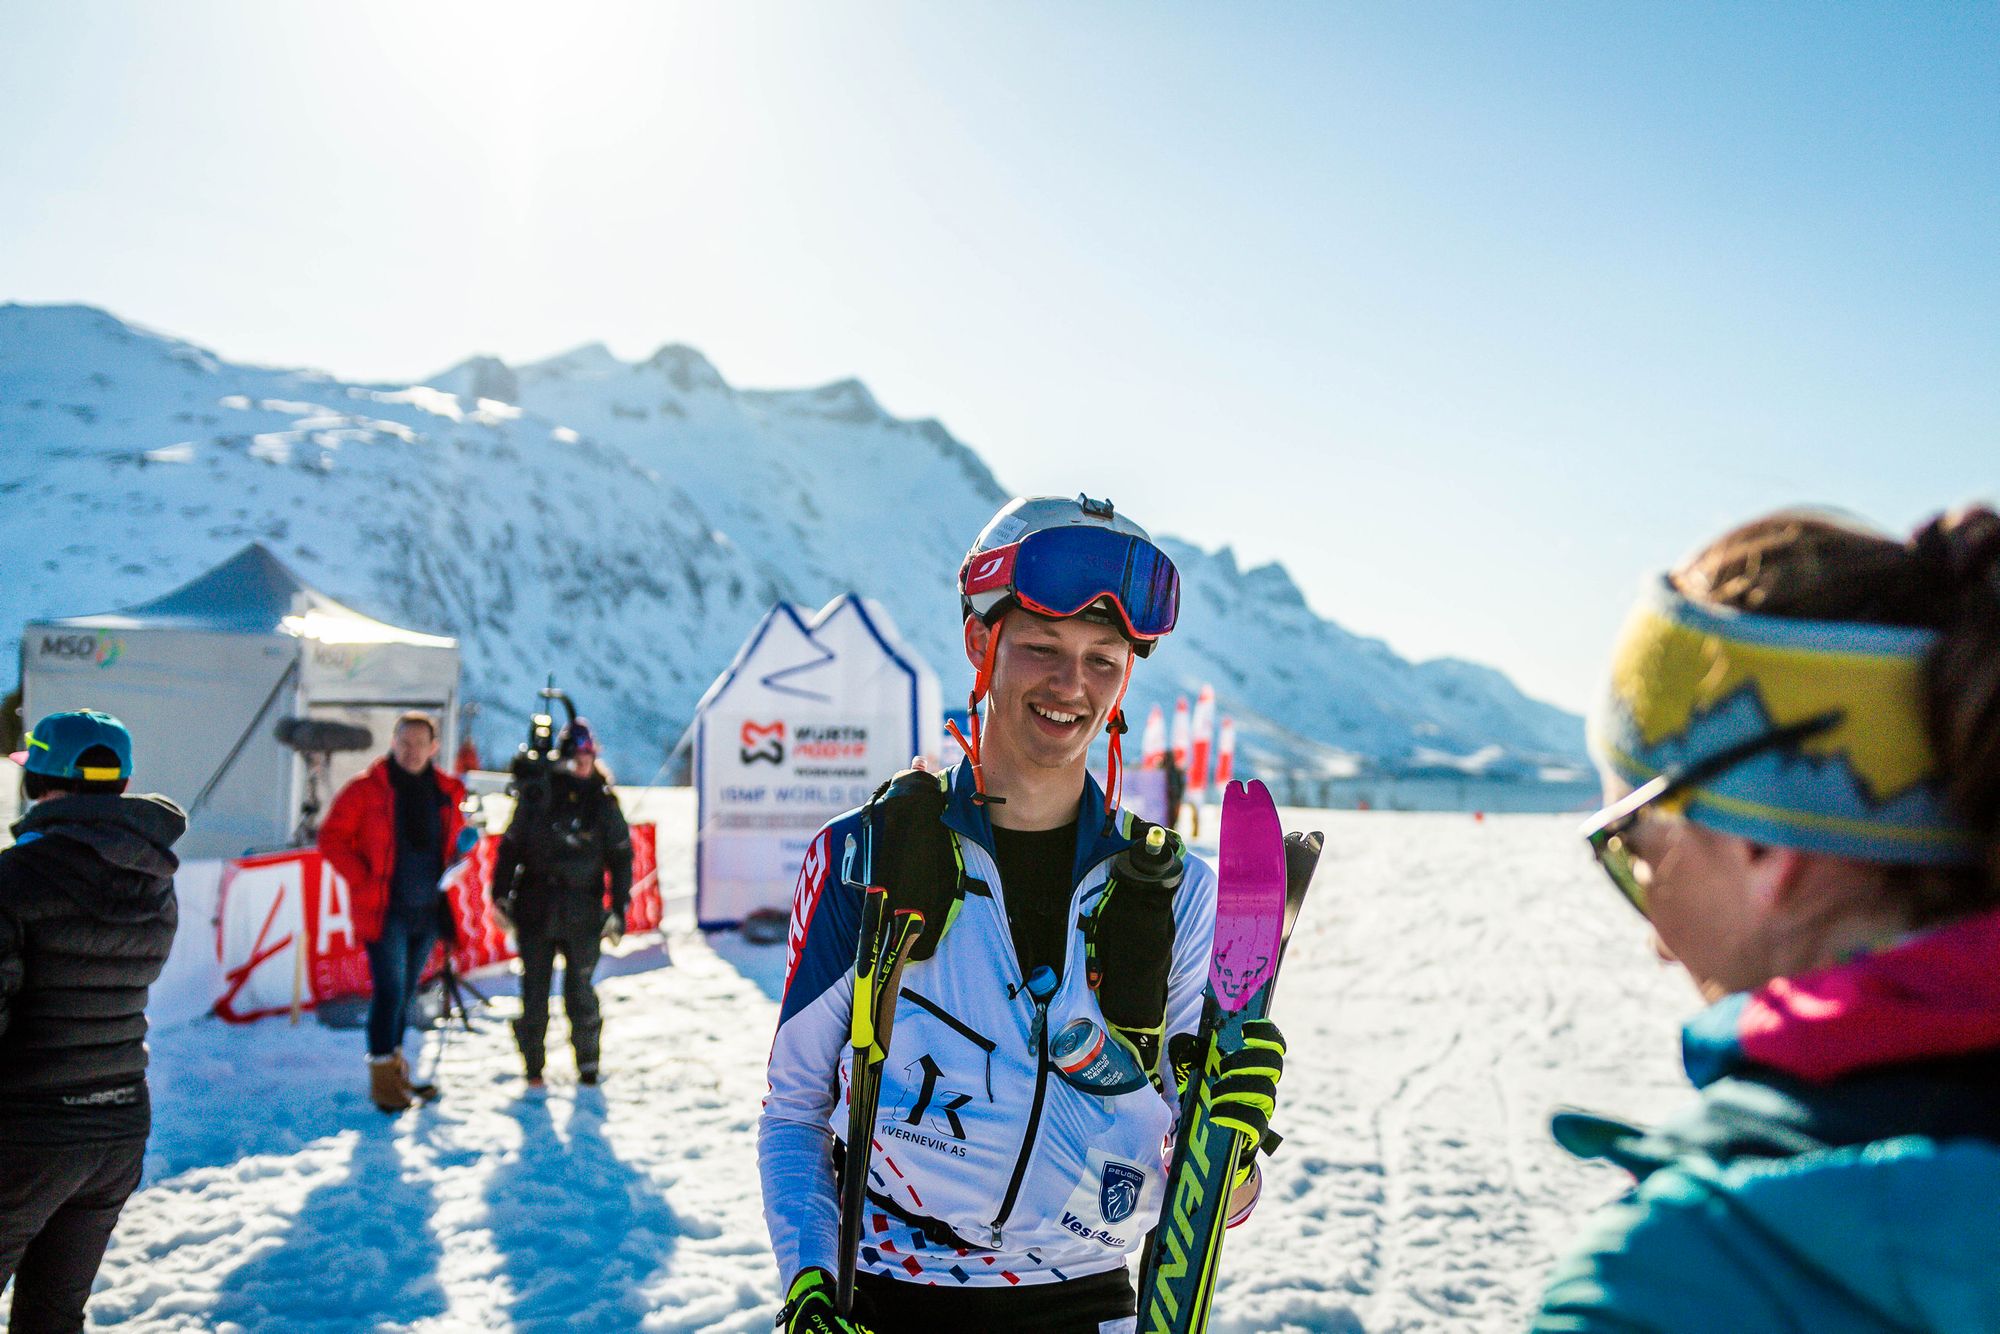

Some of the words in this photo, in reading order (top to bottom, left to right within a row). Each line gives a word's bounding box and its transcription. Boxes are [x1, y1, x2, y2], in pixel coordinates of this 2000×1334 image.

[40, 635, 97, 659] MSO
[878, 951, 897, 983] LEKI
[881, 1125, 948, 1152] KVERNEVIK
[950, 1145, 967, 1157] AS
[1107, 1167, 1142, 1181] PEUGEOT
